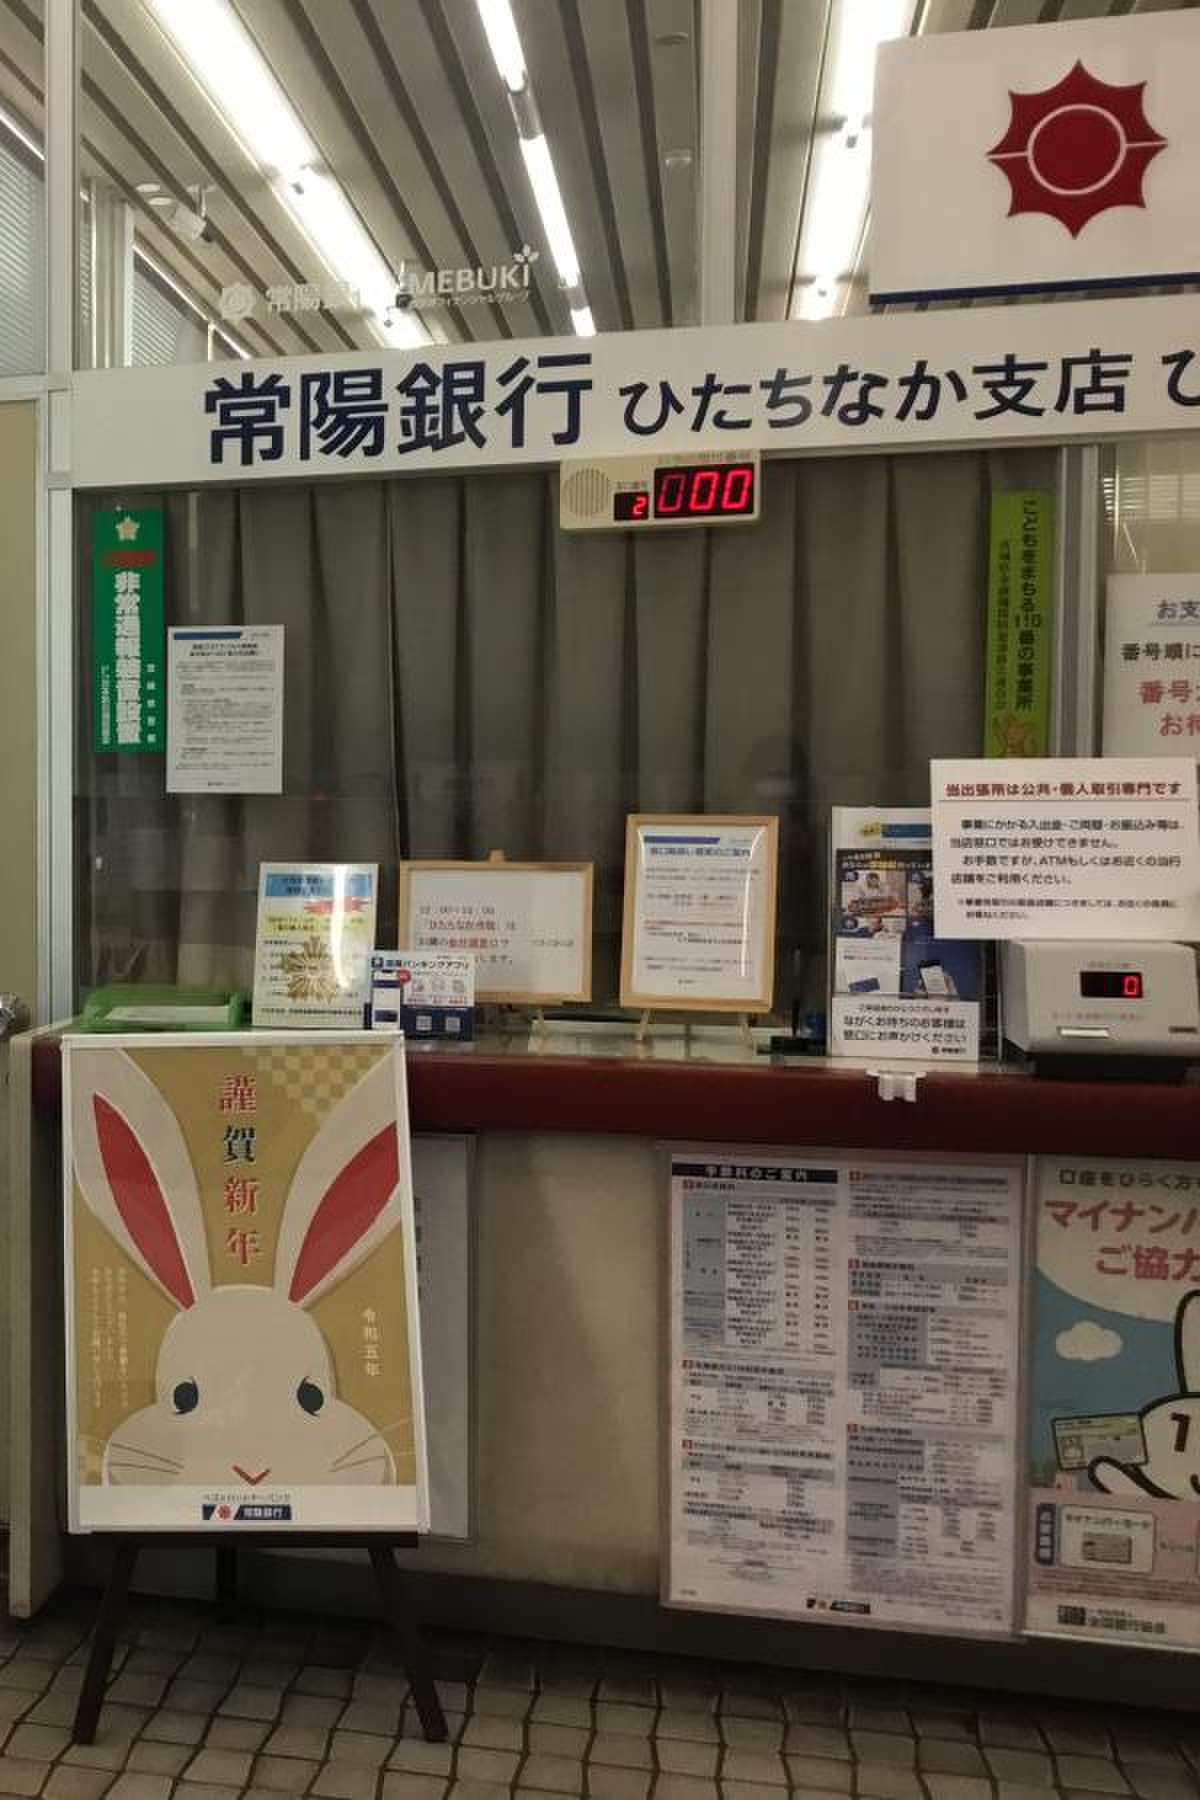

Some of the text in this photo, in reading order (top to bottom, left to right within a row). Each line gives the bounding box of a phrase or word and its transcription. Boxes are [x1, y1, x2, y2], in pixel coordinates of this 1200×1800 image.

[409, 262, 531, 294] MEBUKI
[204, 352, 593, 467] 常陽銀行
[618, 347, 1134, 436] ひたちなか支店
[632, 496, 649, 515] 2
[1138, 680, 1200, 705] 番号
[219, 1075, 261, 1266] 謹賀新年
[1059, 1168, 1200, 1191] 口座をひらく方
